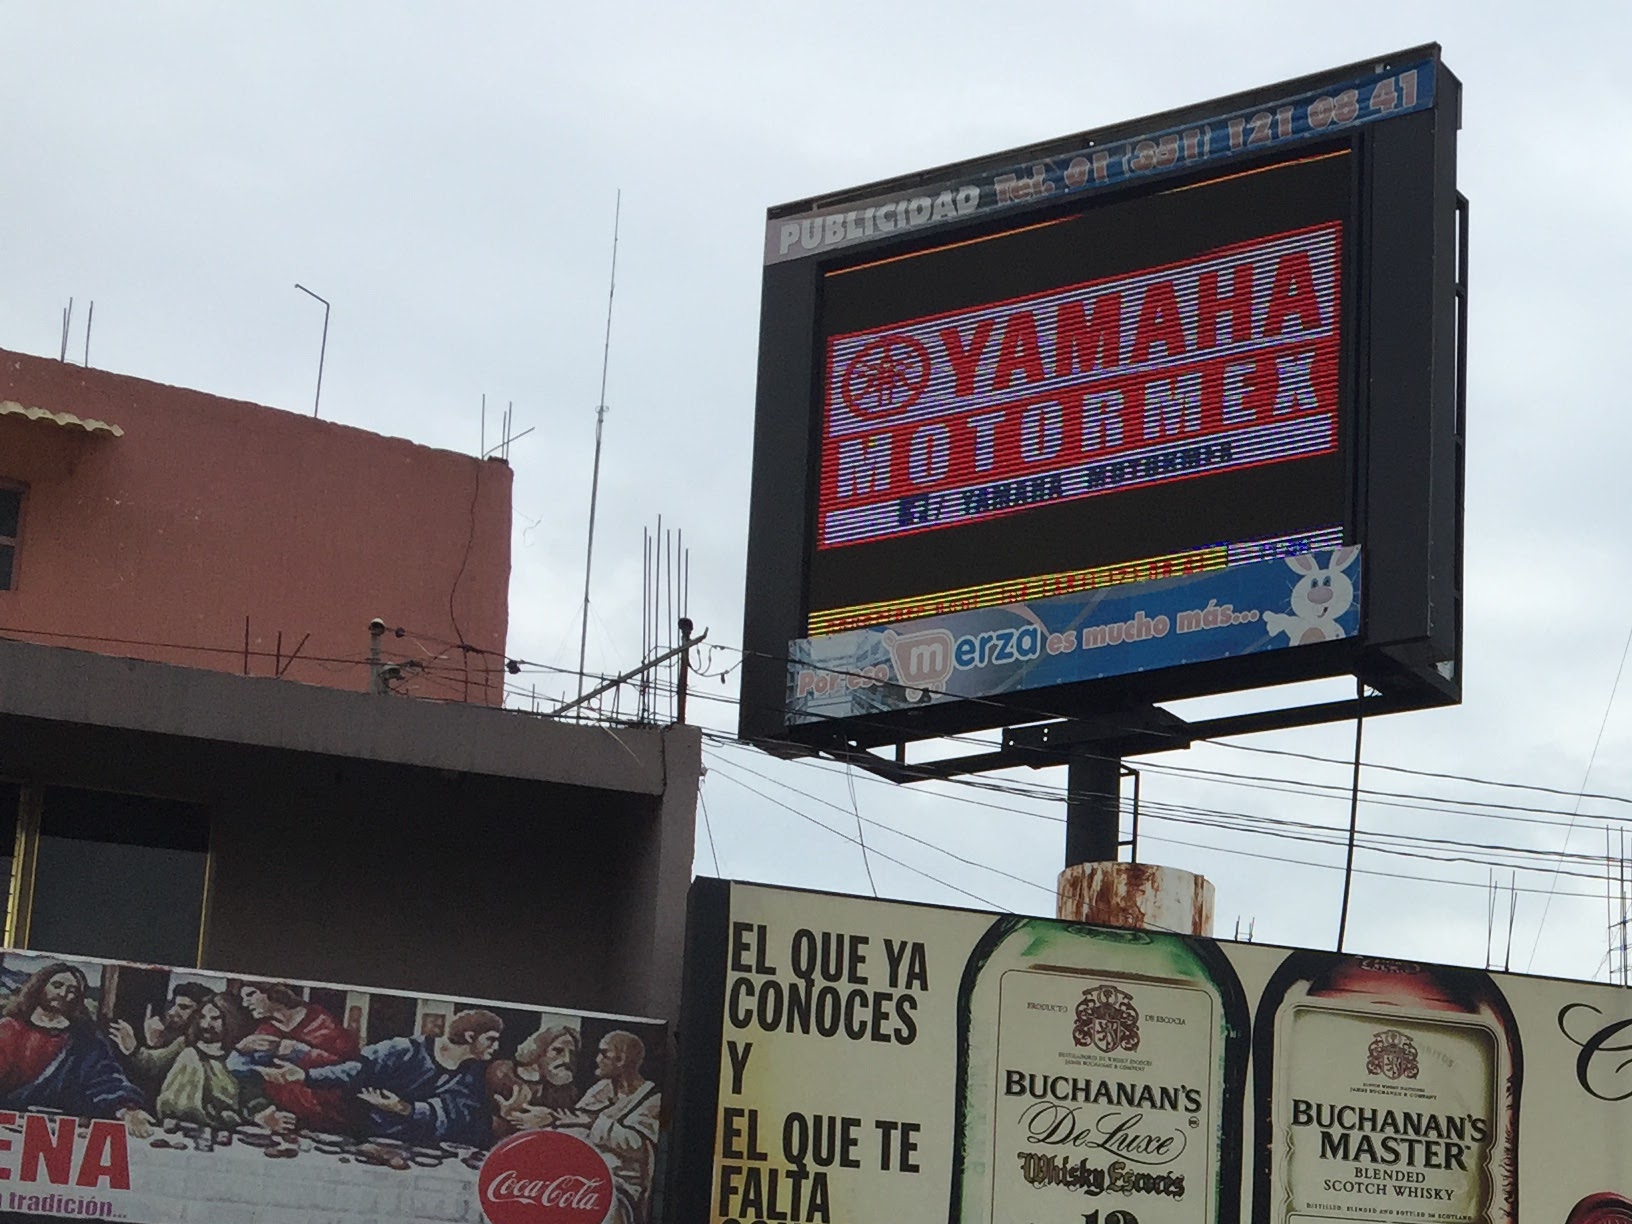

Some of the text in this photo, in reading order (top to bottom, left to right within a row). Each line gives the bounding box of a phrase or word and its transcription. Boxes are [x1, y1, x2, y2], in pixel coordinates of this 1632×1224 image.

[779, 184, 980, 254] PUBLICIDAD
[1063, 151, 1110, 188] 01
[1228, 105, 1294, 150] 121
[1307, 89, 1360, 130] 08
[1370, 69, 1419, 113] 41
[940, 250, 1325, 398] YAMAHA
[836, 350, 1320, 499] MOTORMEX
[798, 669, 842, 697] Por
[1046, 630, 1077, 655] es
[1082, 609, 1170, 650] mucho
[731, 921, 929, 992] EL QUE YA
[728, 977, 918, 1046] CONOCES
[727, 1041, 753, 1095] Y
[1004, 1069, 1202, 1113] BUCHANAN'S
[722, 1107, 921, 1178] EL QUE TE
[1018, 1101, 1187, 1165] De Luxe
[1291, 1098, 1488, 1143] BUCHANAN'S
[1017, 1152, 1105, 1197] Whisky
[1318, 1131, 1469, 1172] MASTER
[1353, 1166, 1427, 1184] BLENDED
[486, 1169, 601, 1212] Coca-Cola
[719, 1165, 831, 1224] FALTA
[1323, 1178, 1455, 1201] SCOTCH WHISKY
